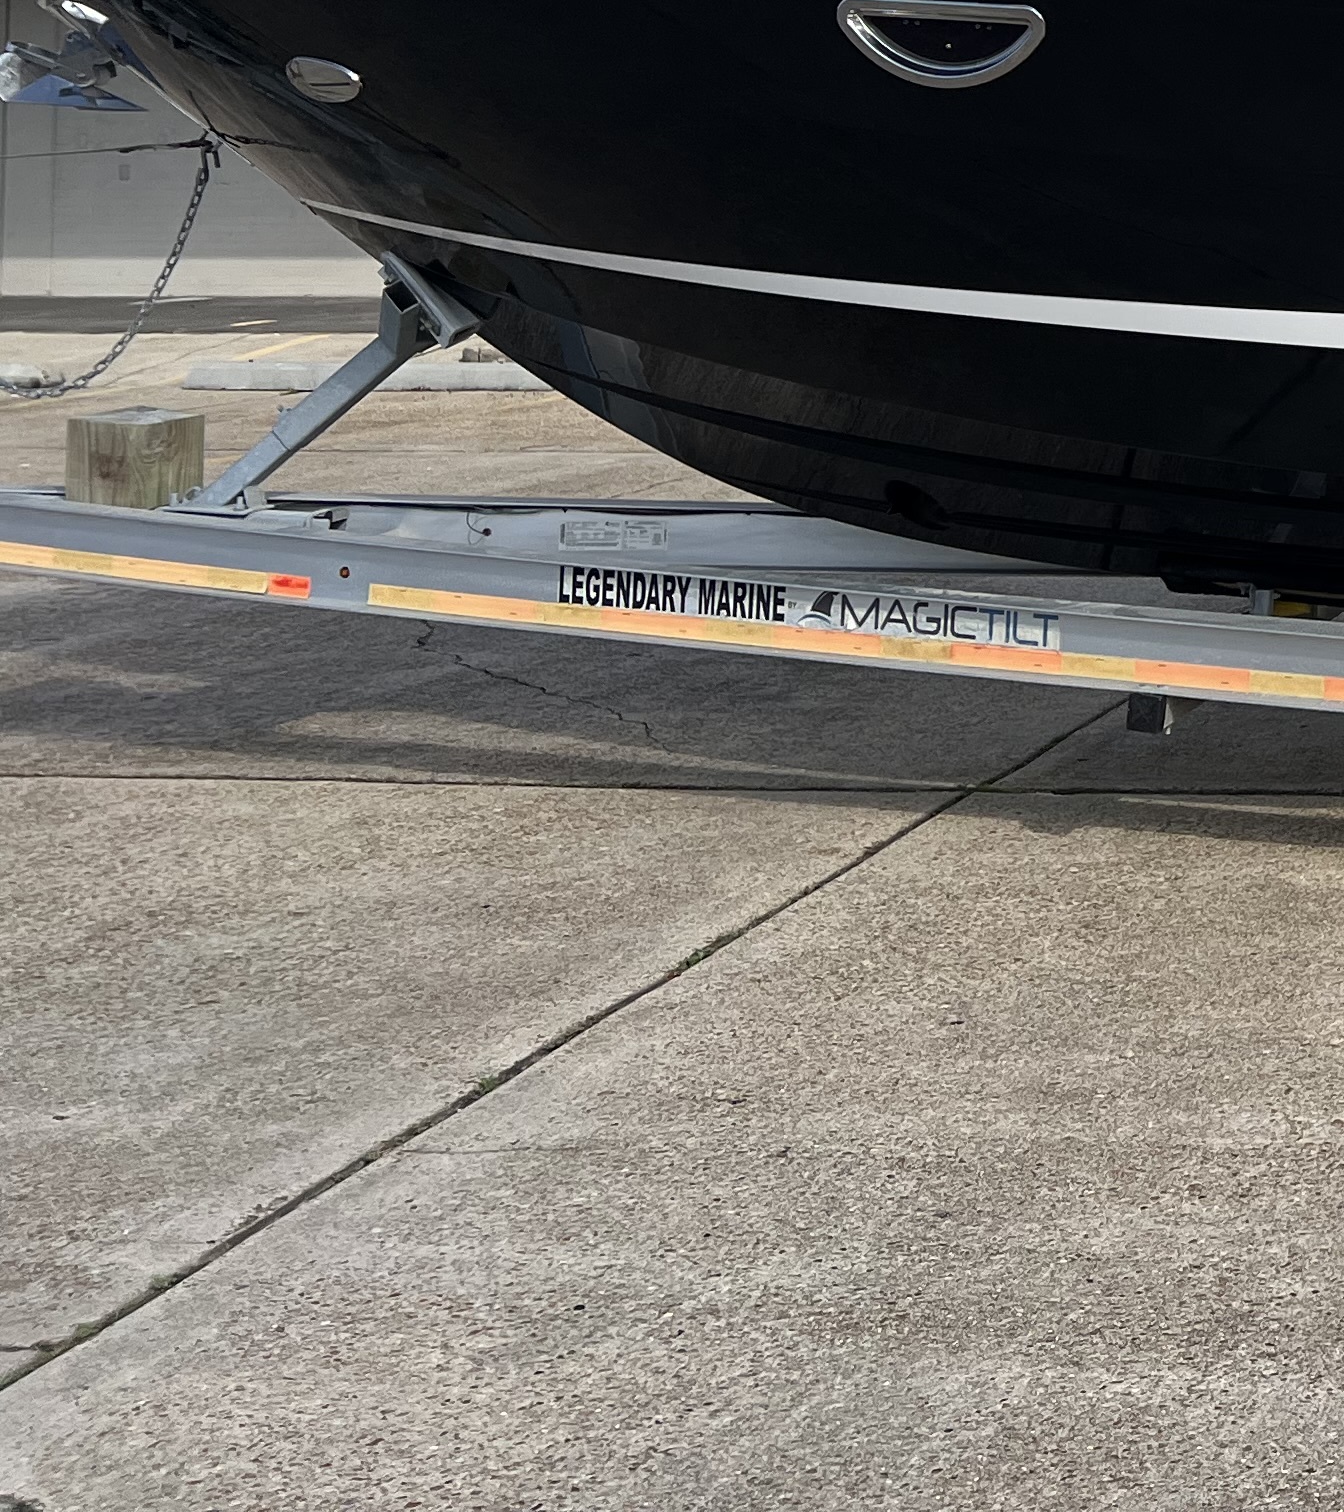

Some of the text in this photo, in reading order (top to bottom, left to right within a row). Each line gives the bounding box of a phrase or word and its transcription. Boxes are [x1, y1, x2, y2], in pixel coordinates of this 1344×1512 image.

[558, 565, 692, 614] LEGENDARY
[698, 576, 787, 623] MARINE
[839, 595, 1059, 648] MAGICTILT
